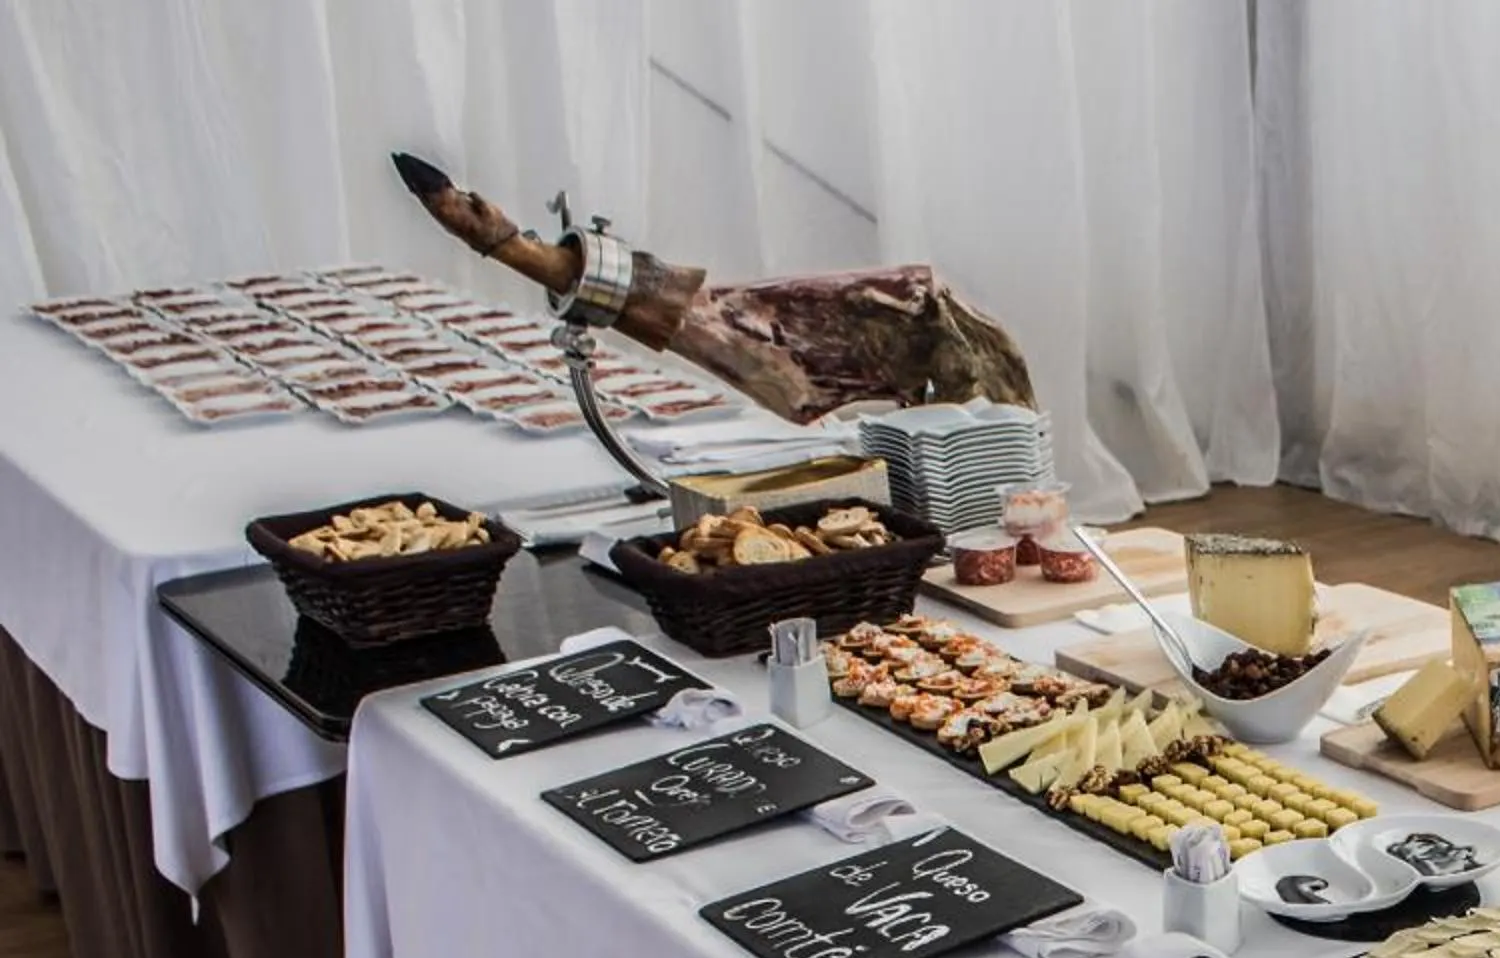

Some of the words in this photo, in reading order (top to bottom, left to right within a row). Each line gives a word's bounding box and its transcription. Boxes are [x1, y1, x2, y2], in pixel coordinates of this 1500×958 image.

[828, 861, 888, 887] de
[911, 849, 992, 904] Queso
[844, 882, 951, 951] VACA
